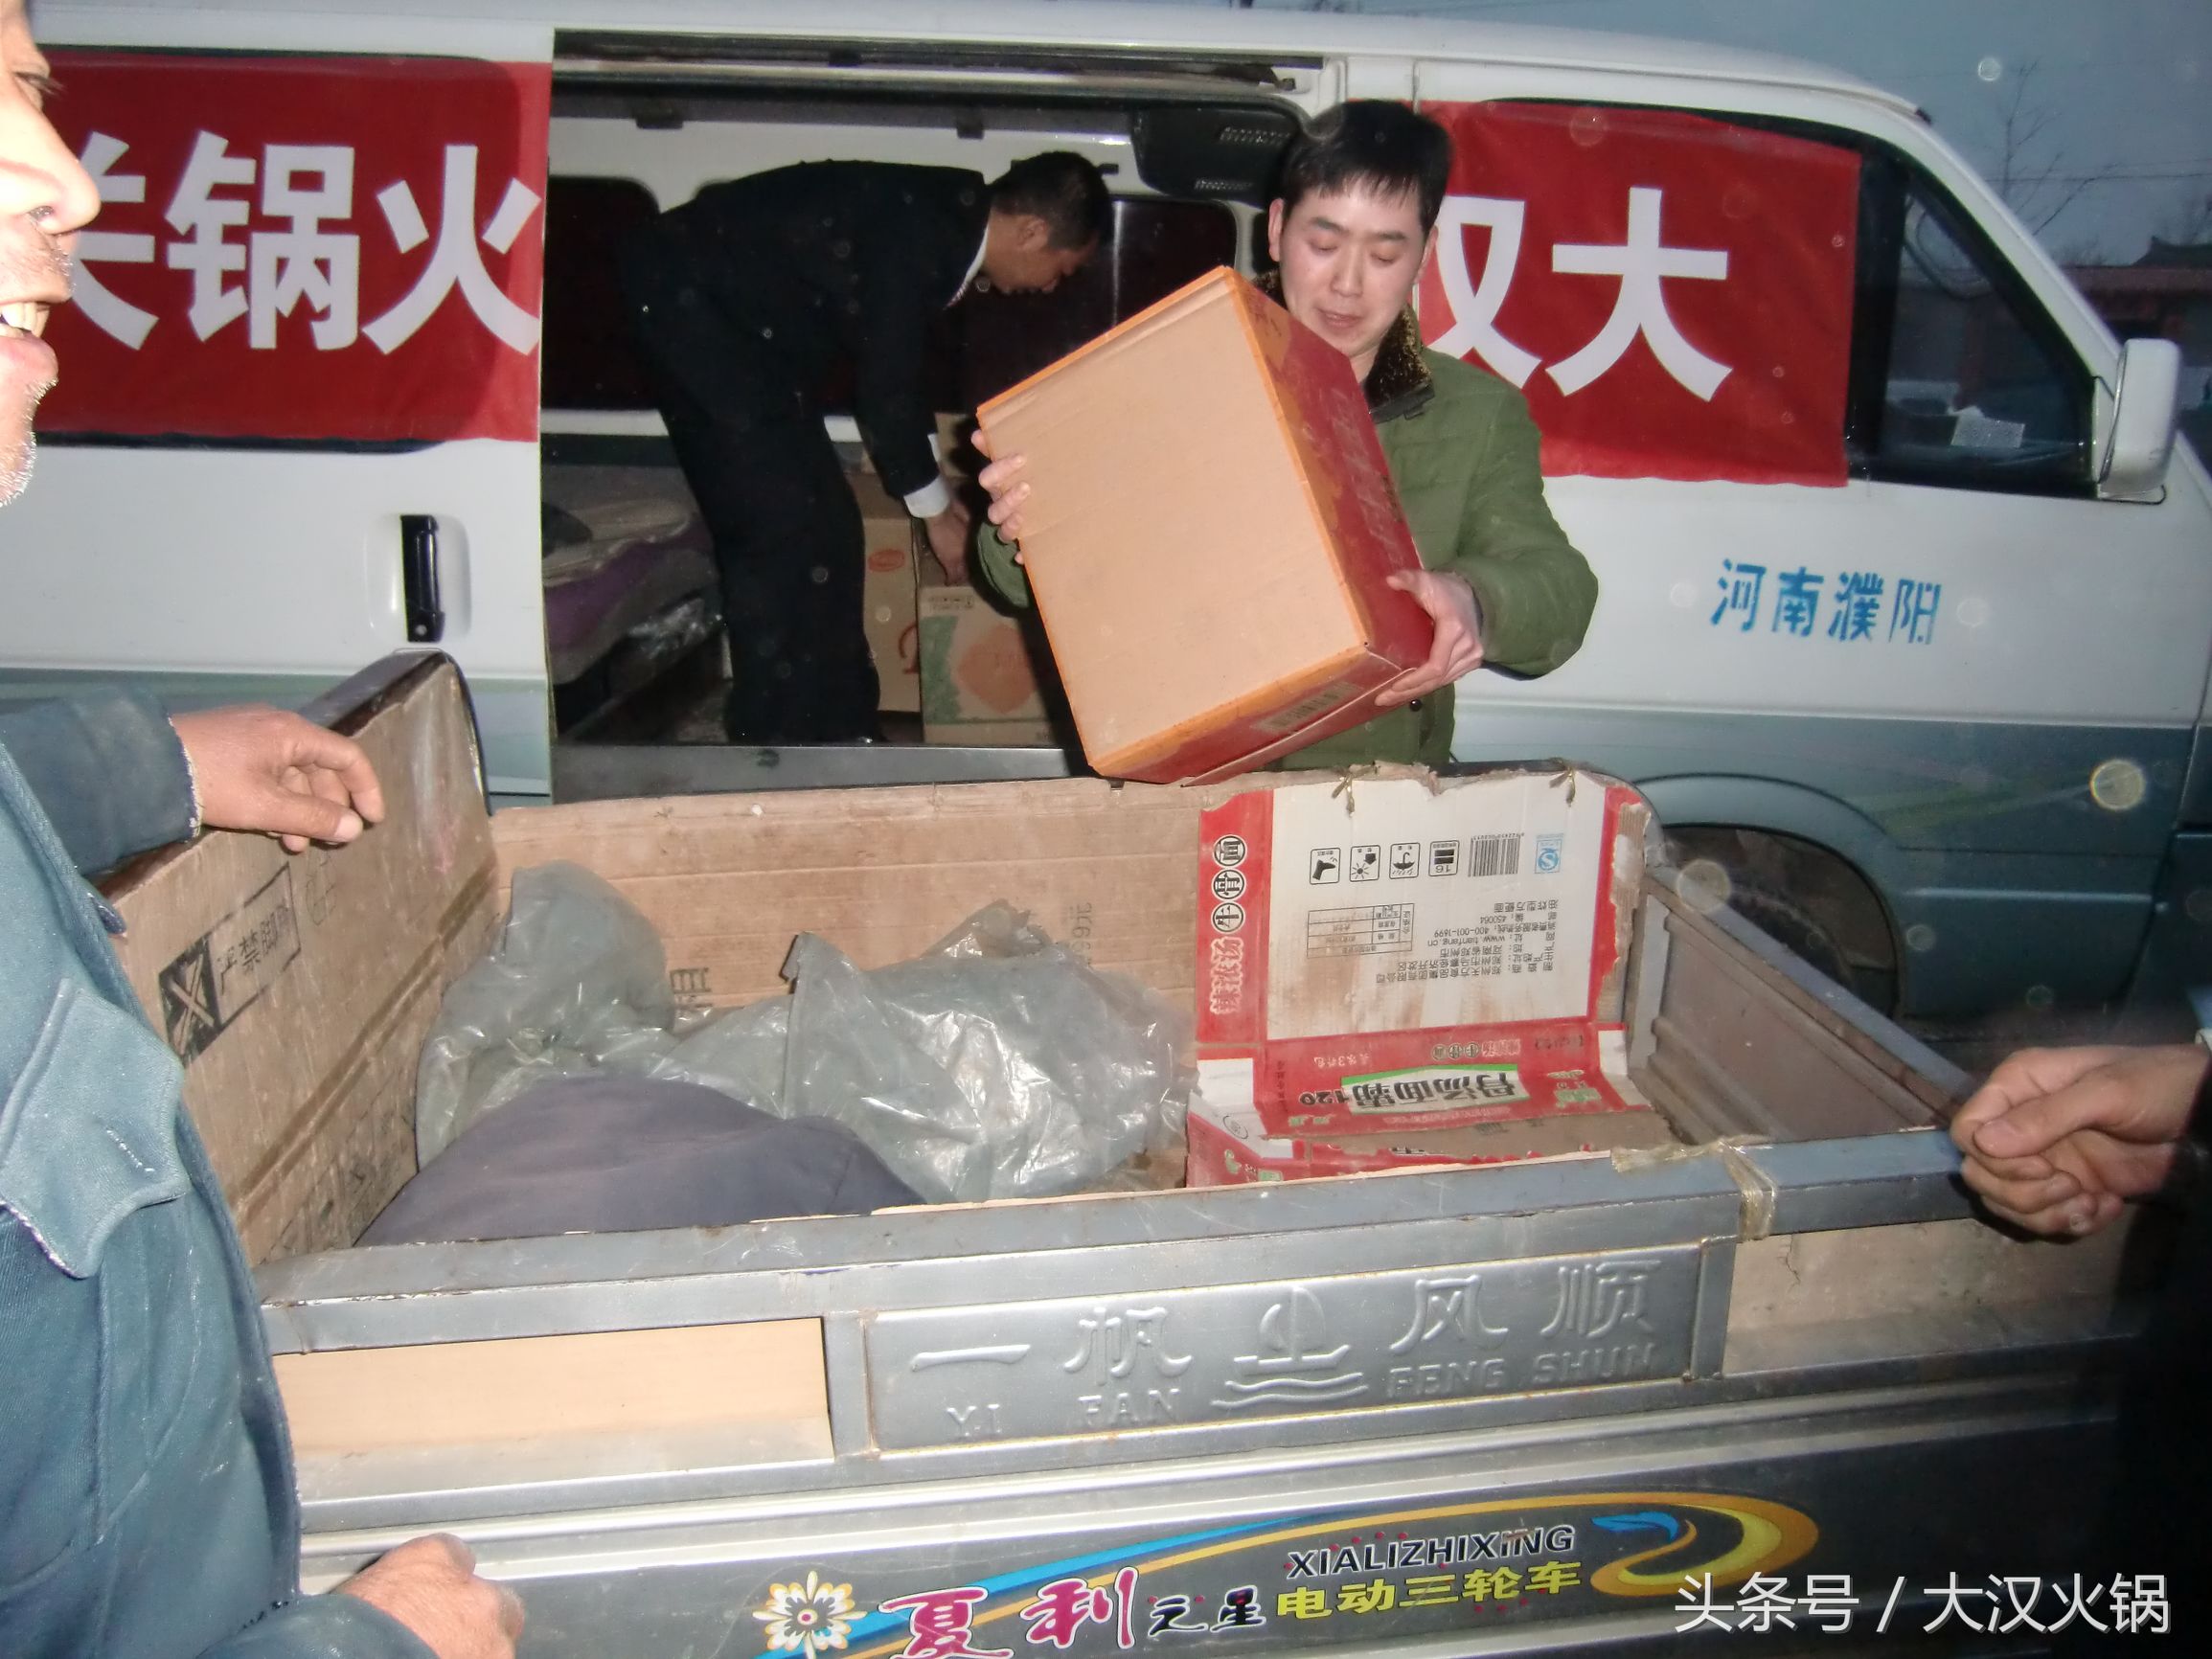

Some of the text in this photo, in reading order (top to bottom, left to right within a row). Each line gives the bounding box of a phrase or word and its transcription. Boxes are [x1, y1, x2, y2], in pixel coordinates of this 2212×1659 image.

[1710, 557, 1942, 646] 河南濮阳
[1494, 899, 1560, 913] 油炸型方便面
[1077, 1387, 1181, 1426] FAN
[1389, 1356, 1506, 1398] FENG
[1533, 1341, 1657, 1384] SHUN
[1276, 1560, 1582, 1621] 电动三轮车
